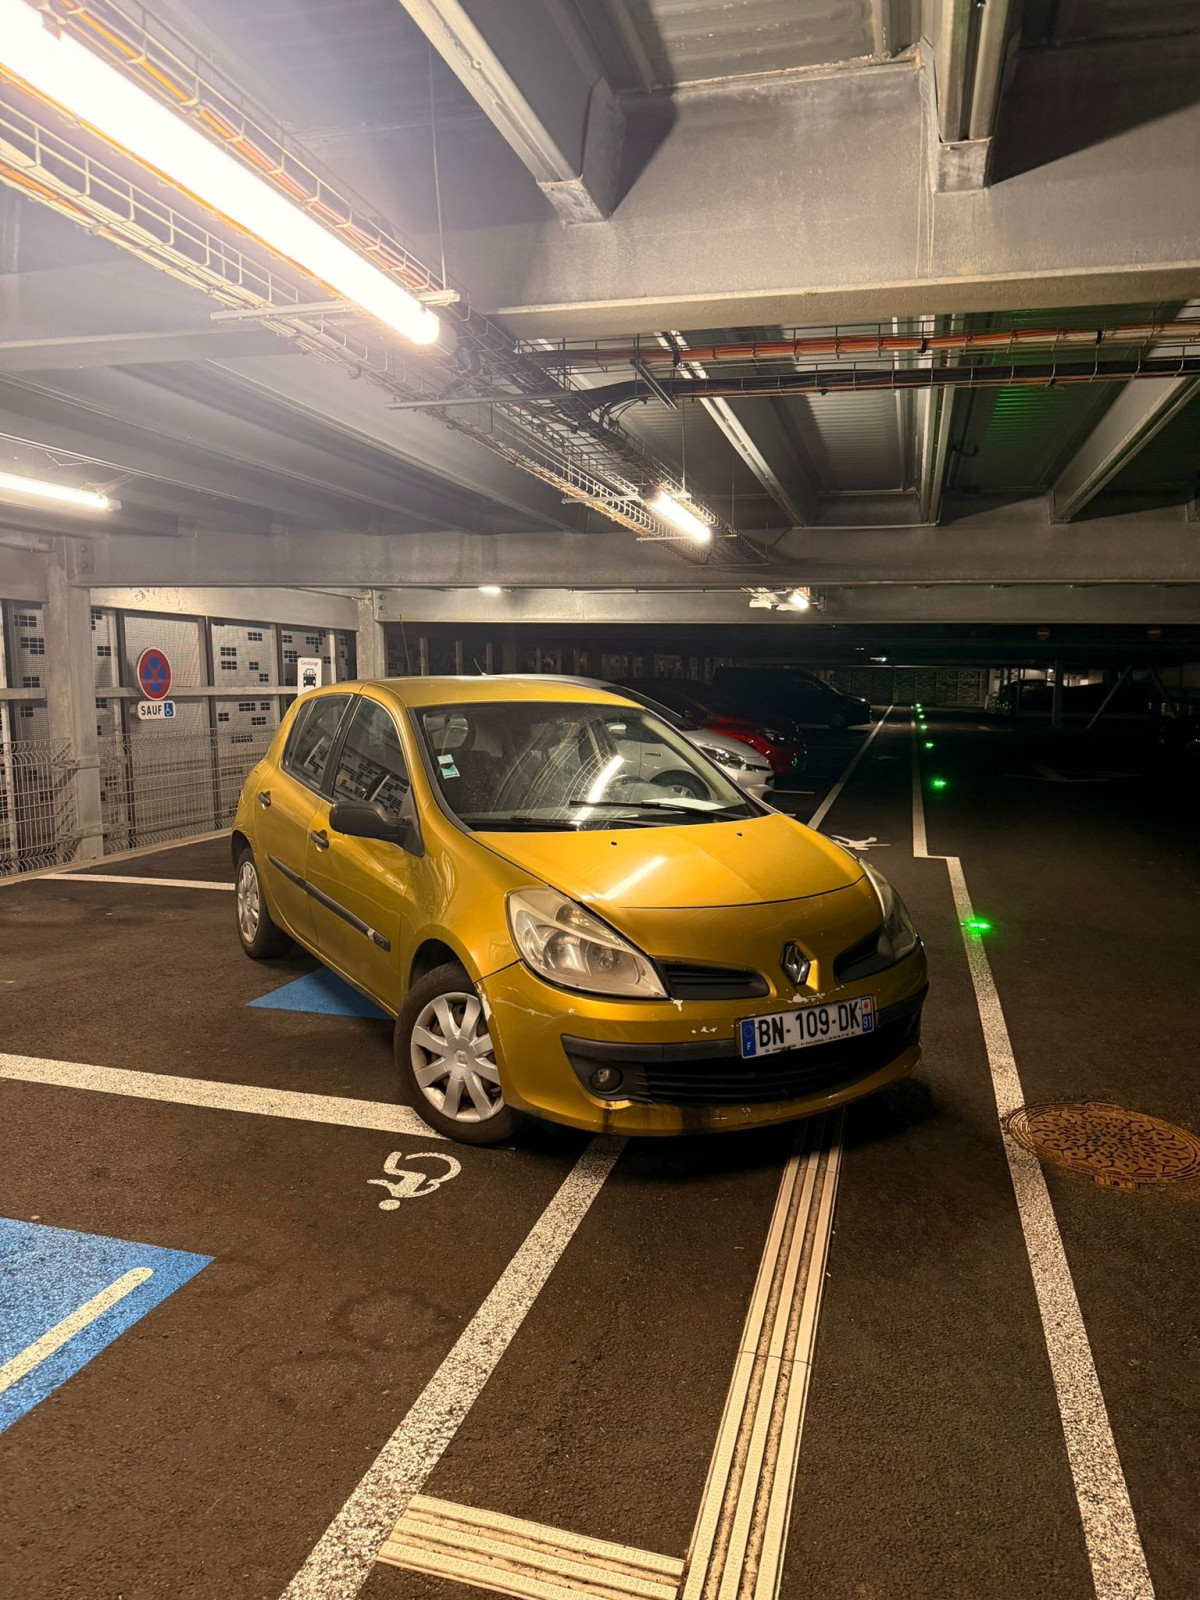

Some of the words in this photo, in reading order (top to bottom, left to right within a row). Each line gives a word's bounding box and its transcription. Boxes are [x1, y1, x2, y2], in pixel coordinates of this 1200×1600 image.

[140, 705, 163, 716] SAUF
[758, 1001, 861, 1048] BN-109-DK
[863, 1016, 872, 1029] 91
[746, 1042, 751, 1051] F
